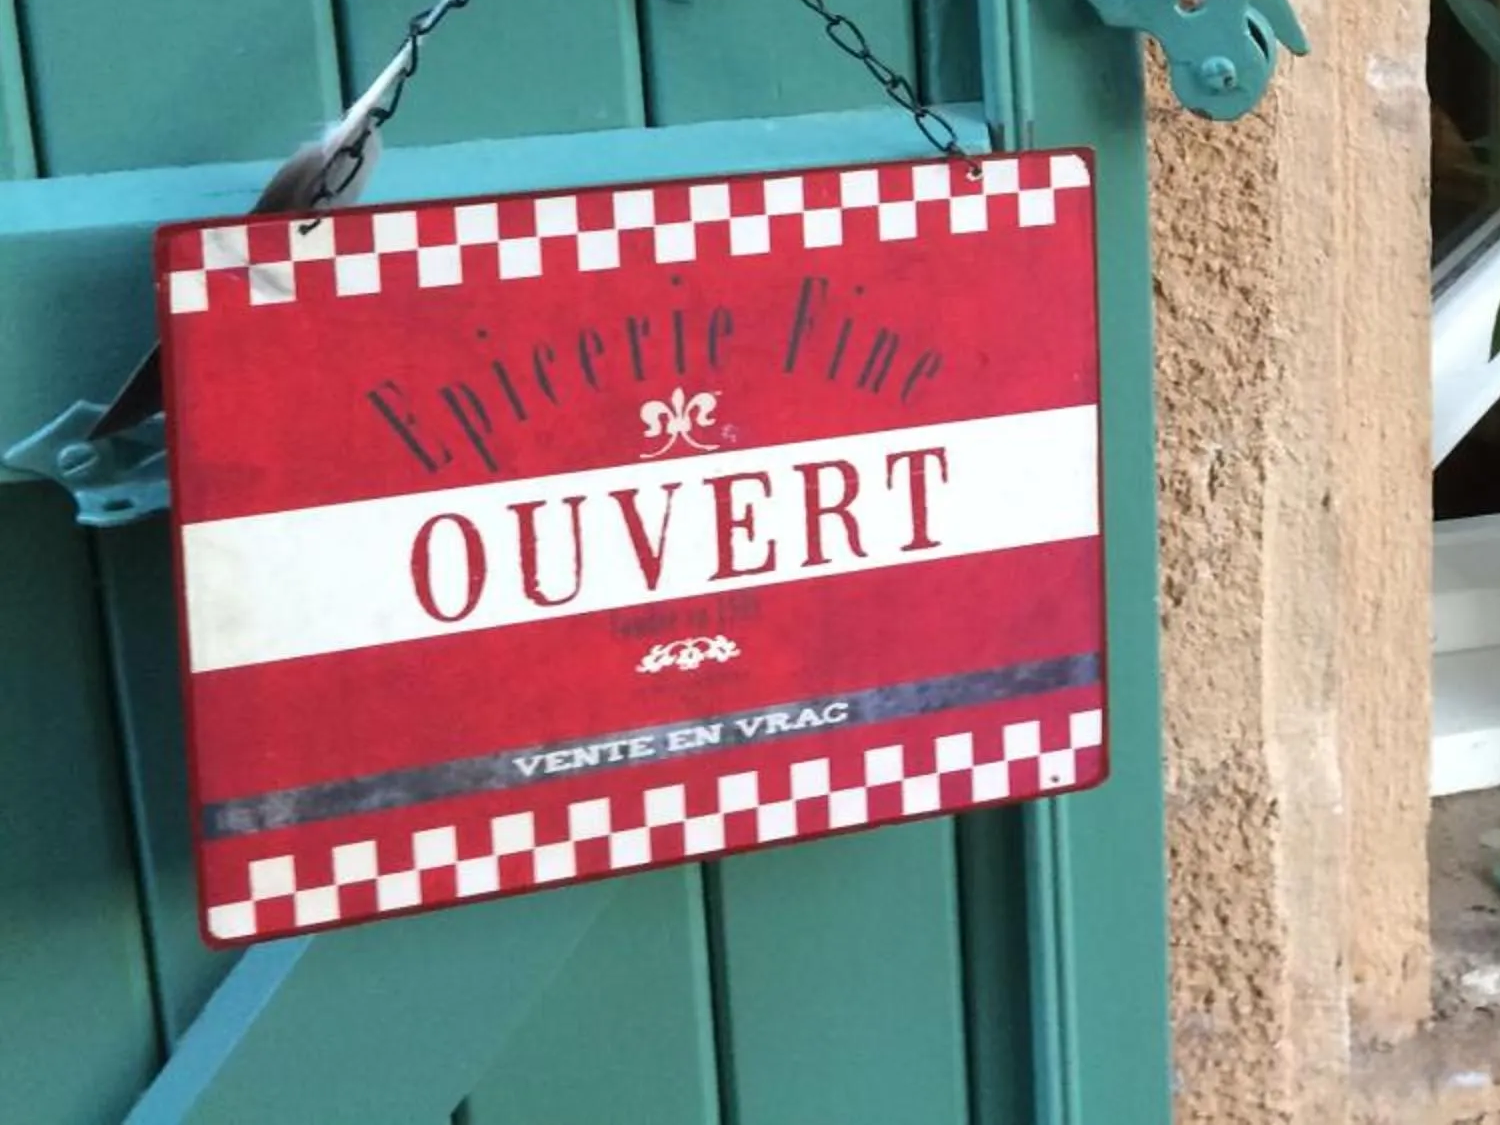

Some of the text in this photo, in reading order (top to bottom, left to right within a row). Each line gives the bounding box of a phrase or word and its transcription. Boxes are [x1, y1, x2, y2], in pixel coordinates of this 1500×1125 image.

[367, 276, 943, 473] Epicerie Fine
[409, 447, 949, 623] OUVERT
[513, 702, 849, 776] VENTE EN VRAC
